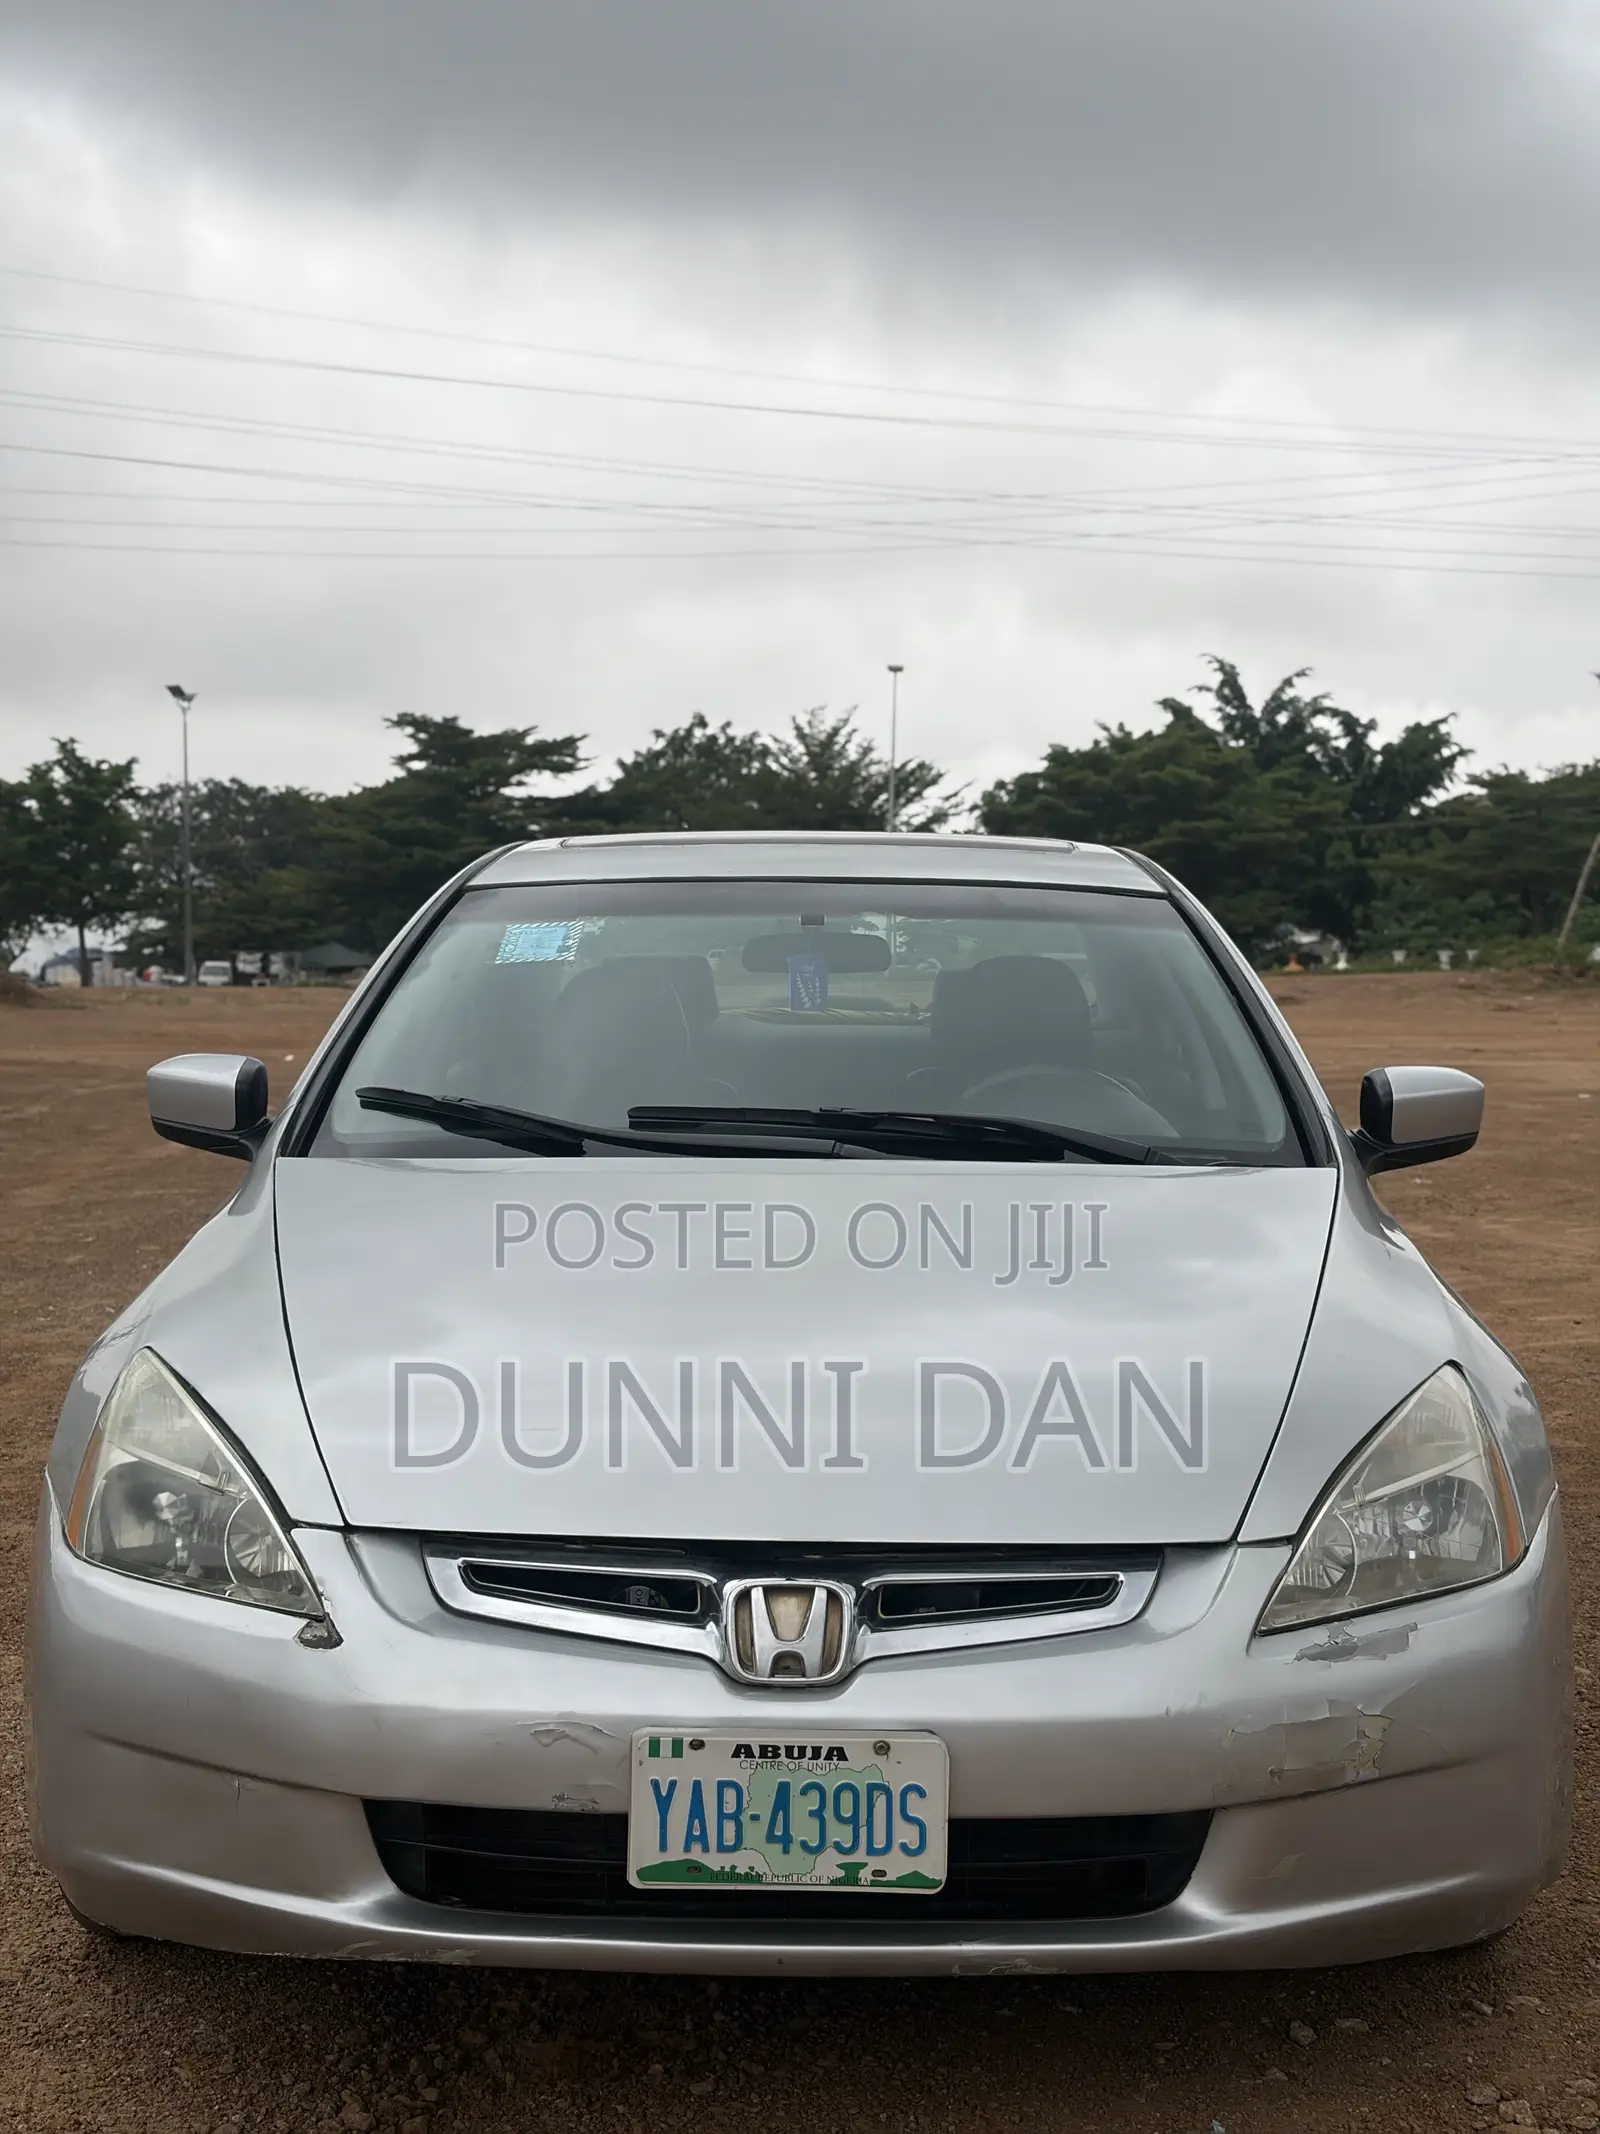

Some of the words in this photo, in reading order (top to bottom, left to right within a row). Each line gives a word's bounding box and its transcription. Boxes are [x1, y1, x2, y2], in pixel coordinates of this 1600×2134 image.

[731, 1743, 849, 1761] ABUJA
[739, 1759, 784, 1771] CENTRE
[786, 1761, 805, 1771] OF
[807, 1762, 841, 1772] UNITY
[649, 1777, 928, 1857] YAB-439DS
[709, 1872, 758, 1882] FEDERAL
[758, 1872, 808, 1883] REPUBLIC
[809, 1874, 825, 1883] OF
[827, 1875, 870, 1885] NIGERIA
